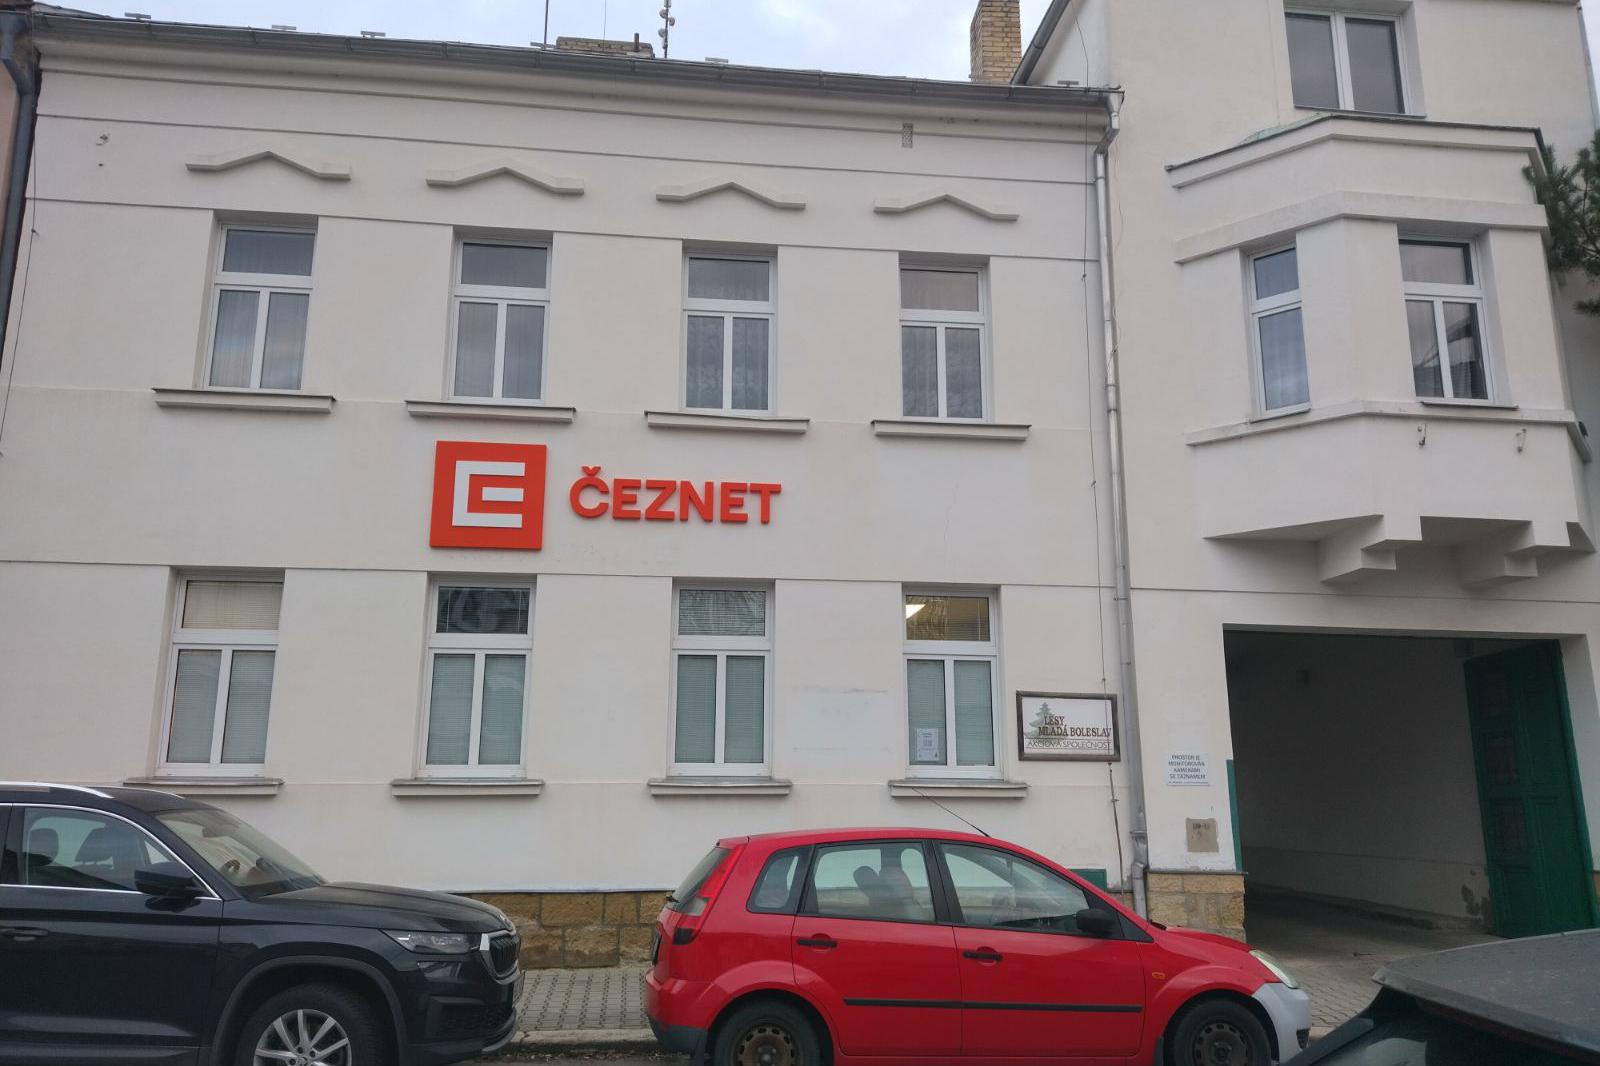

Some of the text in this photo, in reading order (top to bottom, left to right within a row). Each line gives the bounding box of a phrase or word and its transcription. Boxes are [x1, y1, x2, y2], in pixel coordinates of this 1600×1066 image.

[569, 465, 782, 525] ČEZNET
[1044, 715, 1065, 725] LESY
[1038, 725, 1112, 738] MLADÁ BOLESLAV
[1063, 740, 1112, 750] SPOLEČNOST
